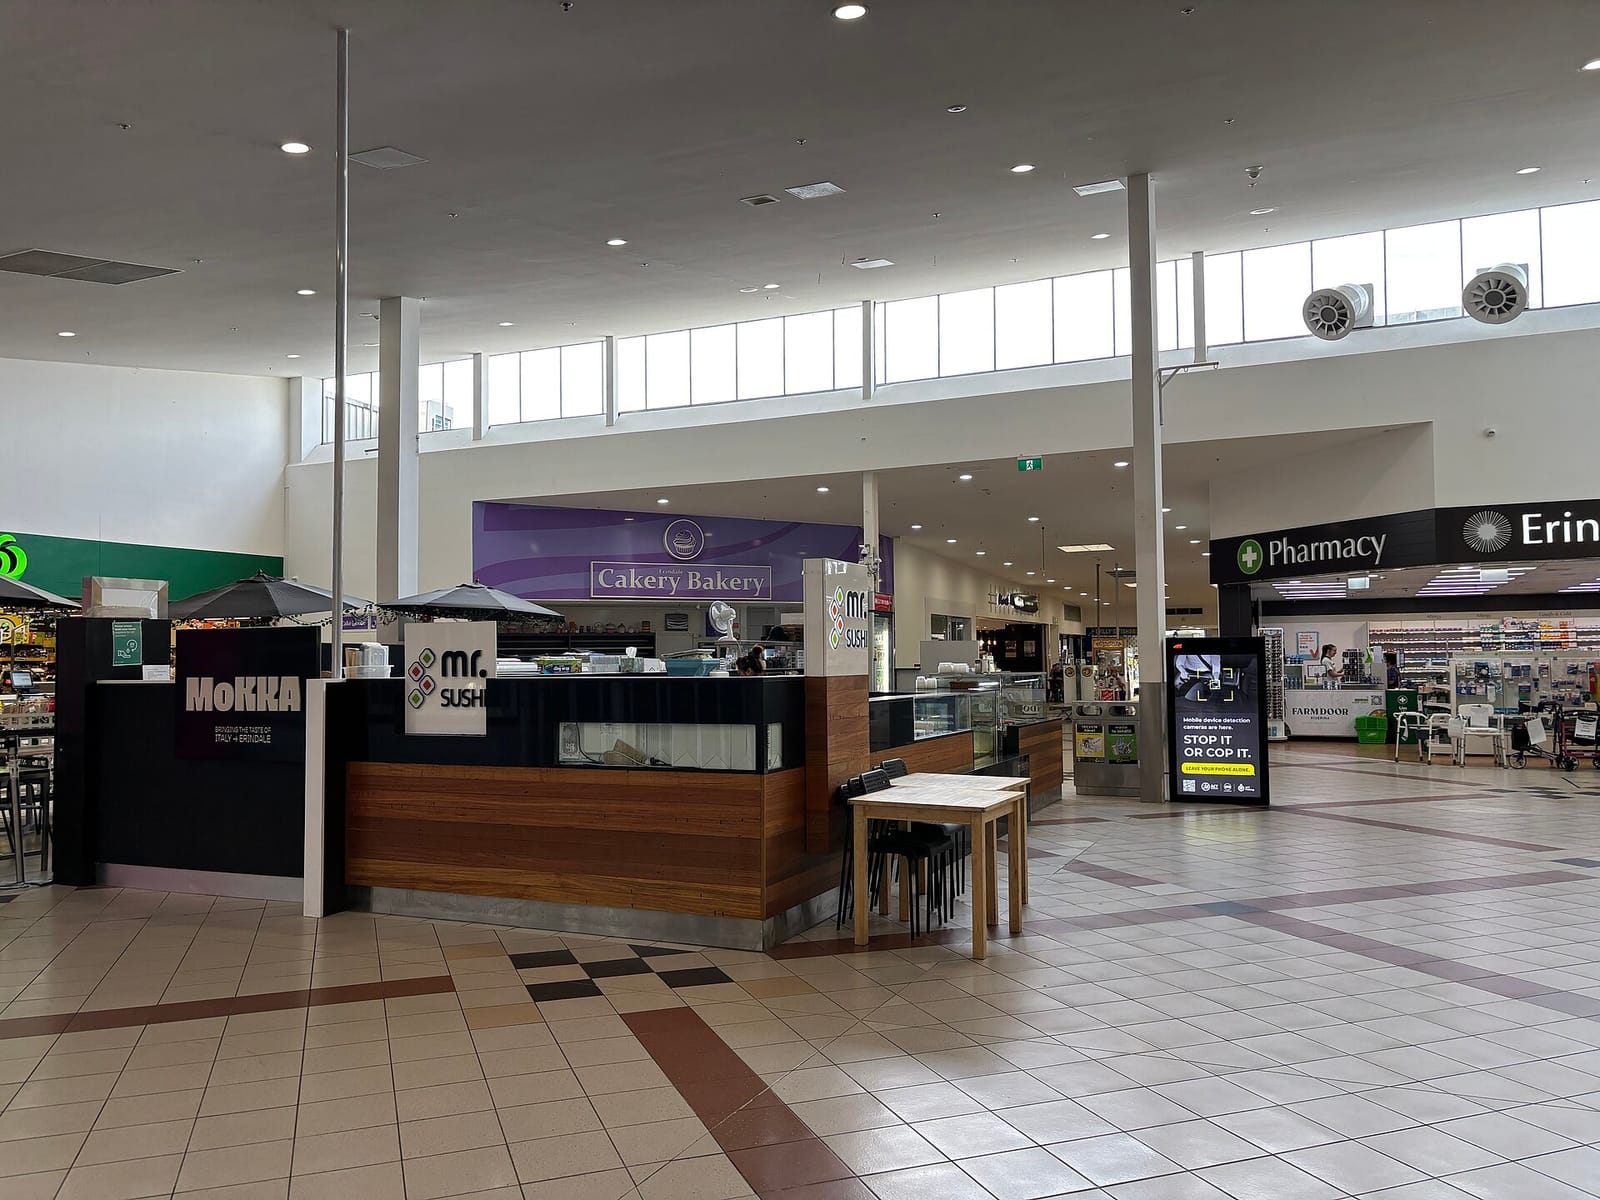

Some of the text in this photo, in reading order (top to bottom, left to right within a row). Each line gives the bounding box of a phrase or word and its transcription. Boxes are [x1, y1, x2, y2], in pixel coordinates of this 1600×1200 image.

[1522, 511, 1600, 544] Erin
[1269, 534, 1387, 566] Pharmacy
[598, 568, 764, 596] Cakery Bakery
[845, 590, 867, 619] mr.
[441, 650, 488, 678] mr.
[186, 676, 301, 711] MoKKA
[440, 688, 488, 708] SUSHI
[215, 734, 272, 744] ITALY ERINDALE
[249, 726, 264, 734] TASTE
[1183, 735, 1233, 745] STOP IT
[1184, 747, 1252, 758] OR COP IT.
